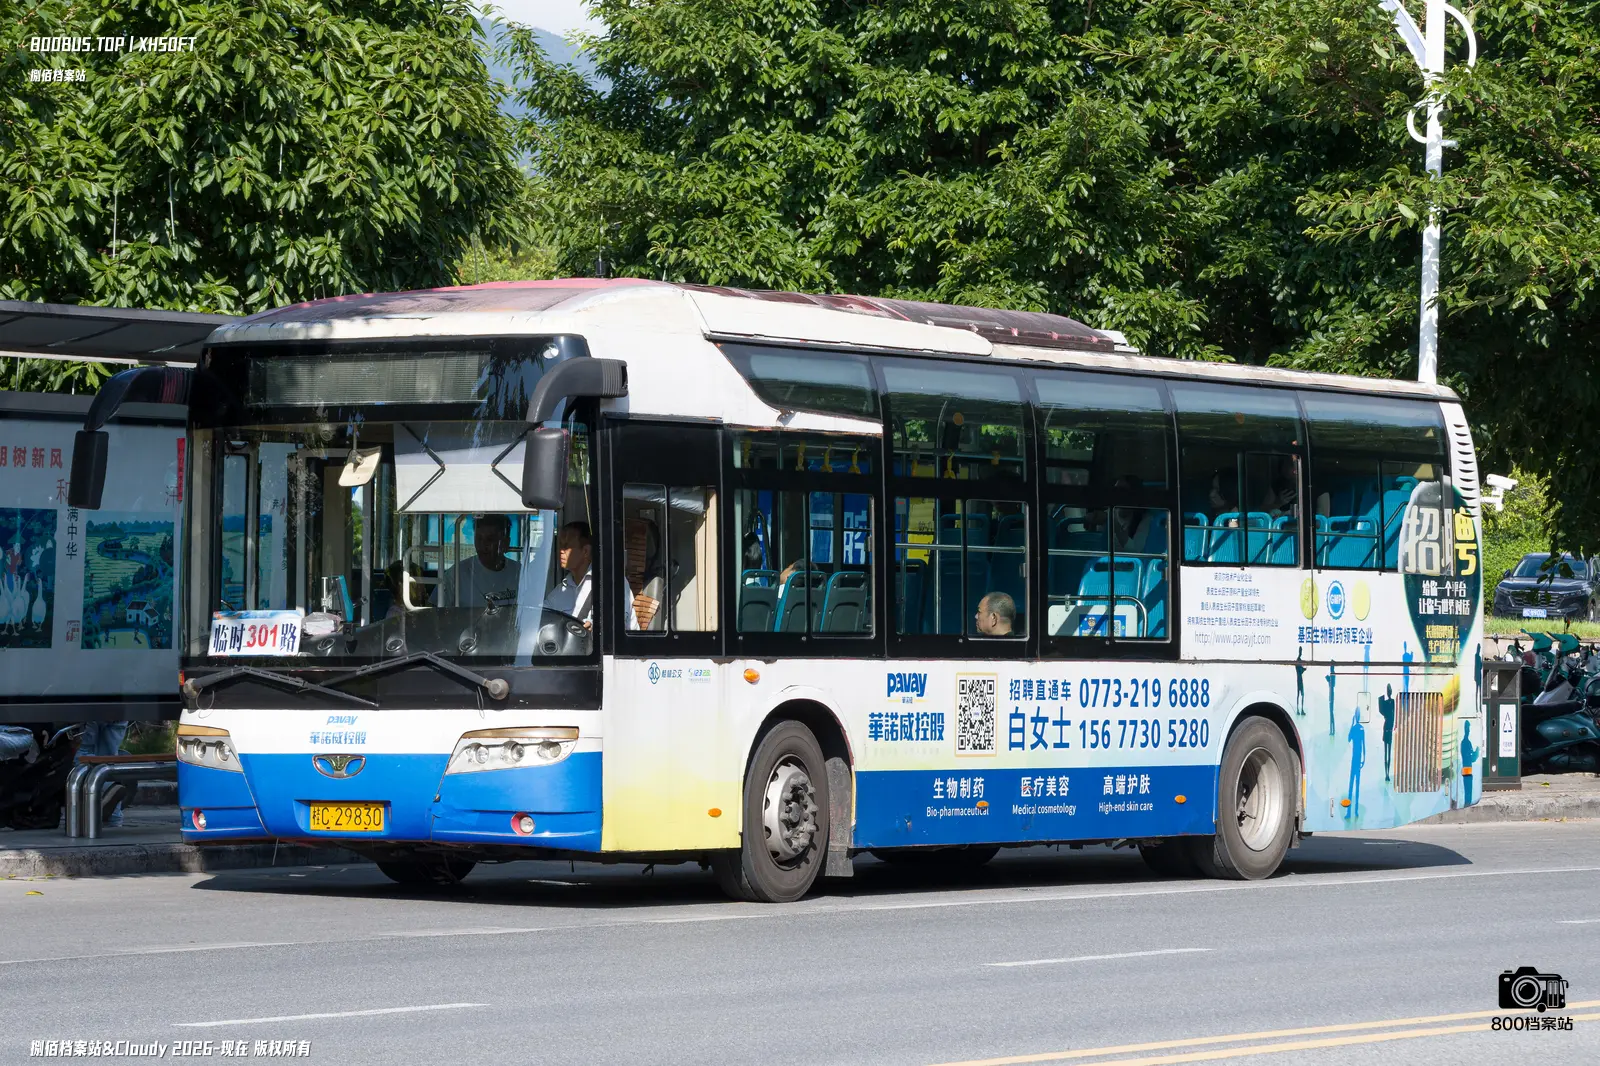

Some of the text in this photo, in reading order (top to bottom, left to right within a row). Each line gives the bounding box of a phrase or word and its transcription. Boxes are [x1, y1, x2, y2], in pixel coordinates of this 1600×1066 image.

[1404, 504, 1478, 577] 招聘
[1422, 580, 1467, 597] 给你一个平台
[1418, 598, 1471, 616] 让你与世界对话
[213, 622, 297, 653] 临时301路
[1298, 626, 1373, 644] 基因生物制药领军企业
[887, 672, 928, 697] pavay
[1009, 678, 1072, 701] 招聘直通车
[1079, 678, 1210, 708] 0773-219 6888
[327, 715, 358, 725] pavay
[868, 712, 945, 741] 華諾威控股
[1008, 706, 1071, 752] 白女士
[1079, 718, 1209, 749] 156 7730 5280
[932, 776, 985, 800] 生物制药
[1020, 775, 1070, 798] 医疗美容
[1102, 773, 1151, 796] 高端护肤
[926, 805, 990, 820] Bio-pharmaceutical
[1012, 803, 1076, 816] Medical cosmetology
[1098, 801, 1153, 814] High-end skin care
